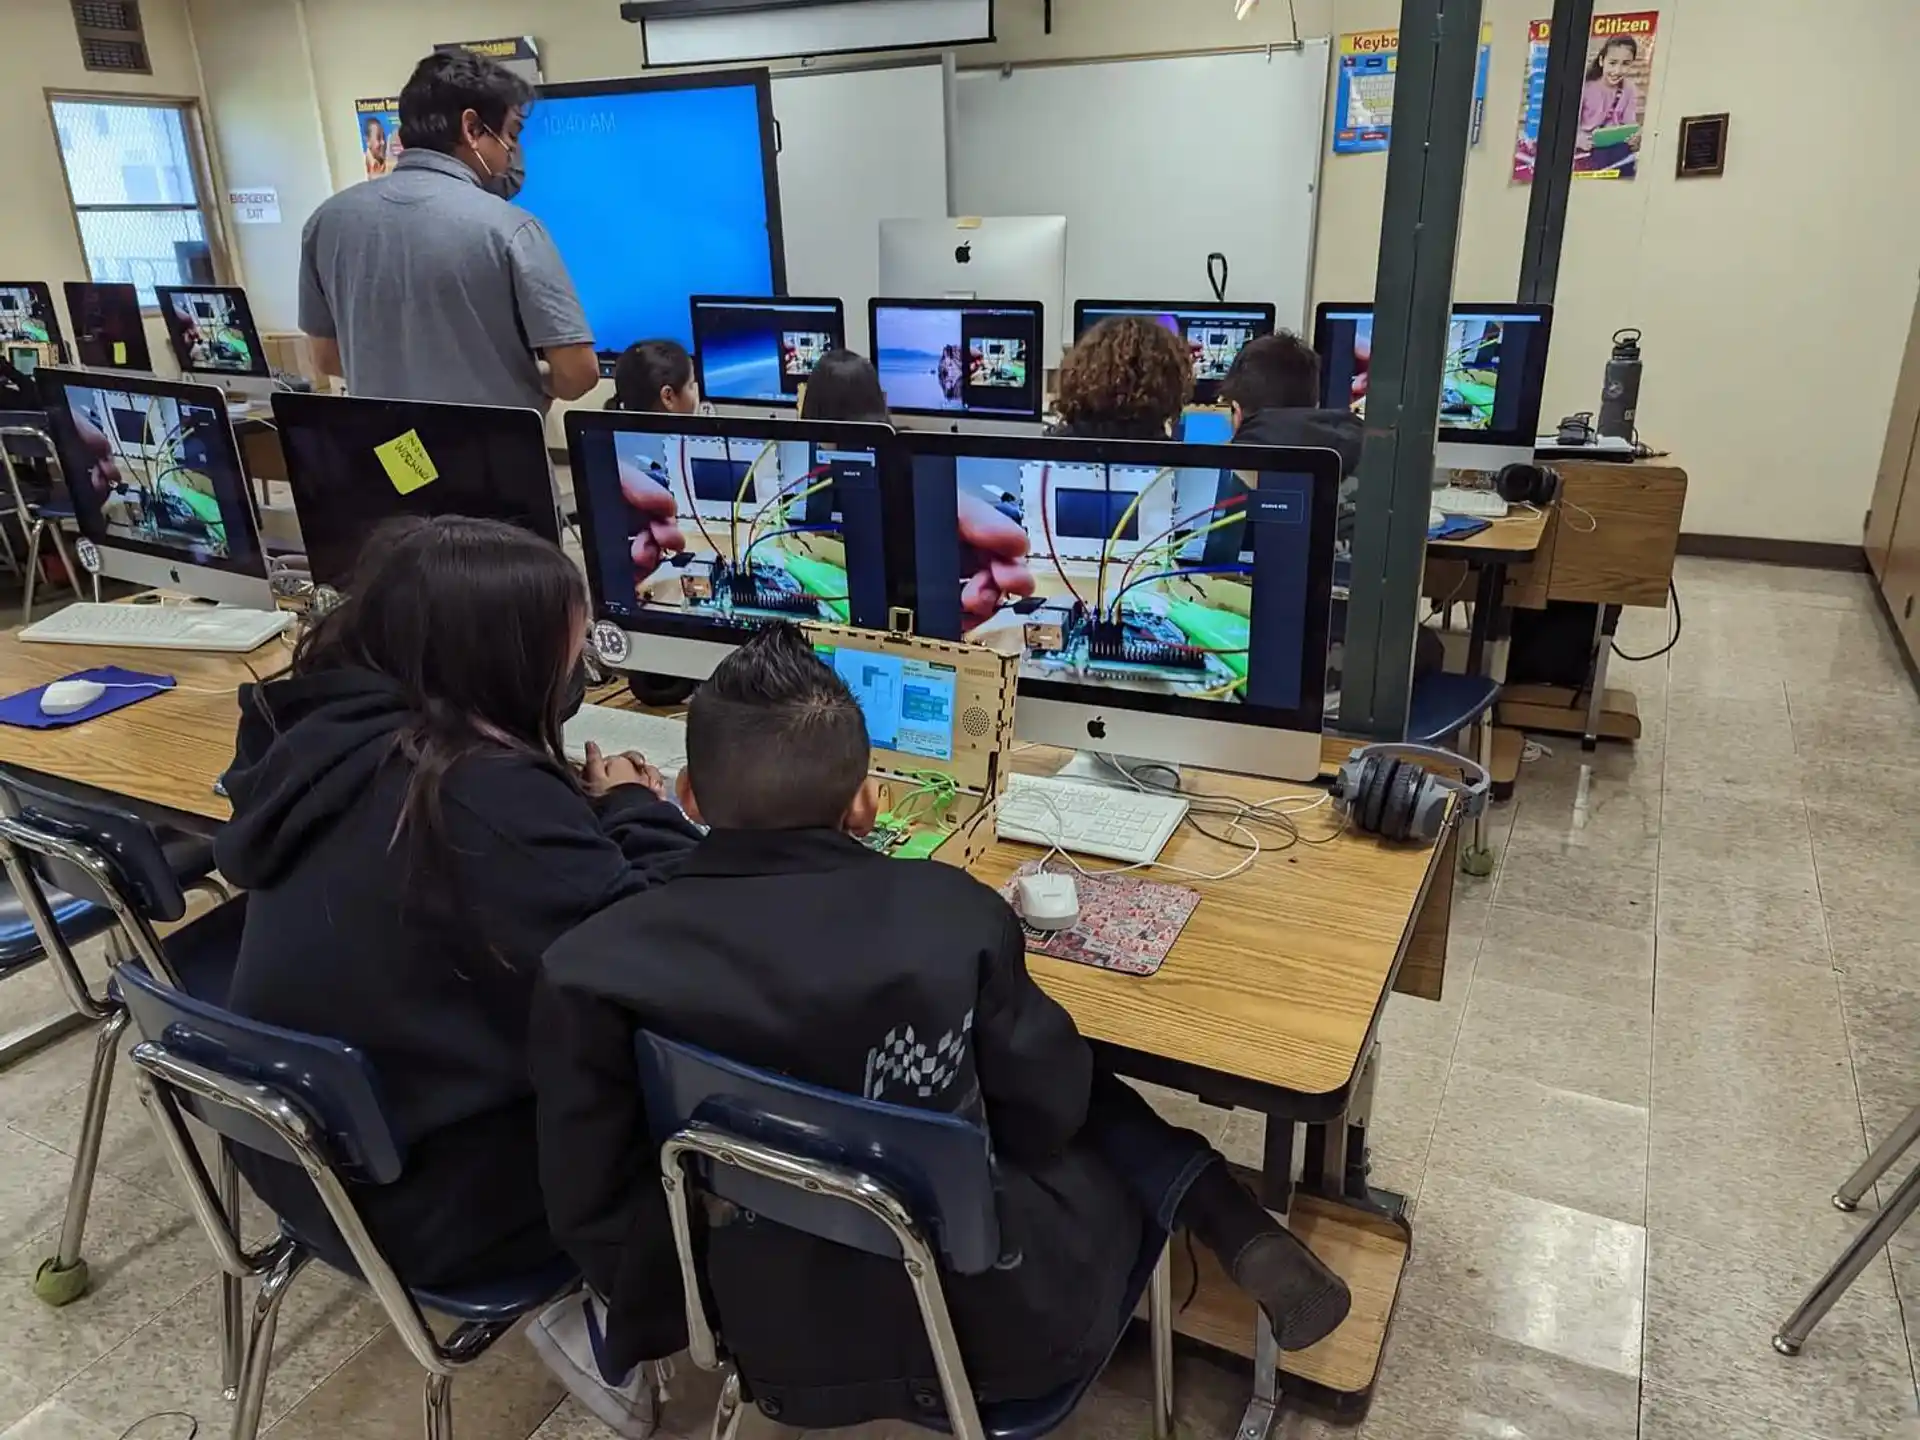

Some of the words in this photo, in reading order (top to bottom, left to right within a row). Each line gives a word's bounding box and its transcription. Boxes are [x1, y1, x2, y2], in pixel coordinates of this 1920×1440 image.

[1594, 17, 1651, 34] Citizen
[589, 111, 617, 133] AM
[246, 207, 264, 220] EXIT
